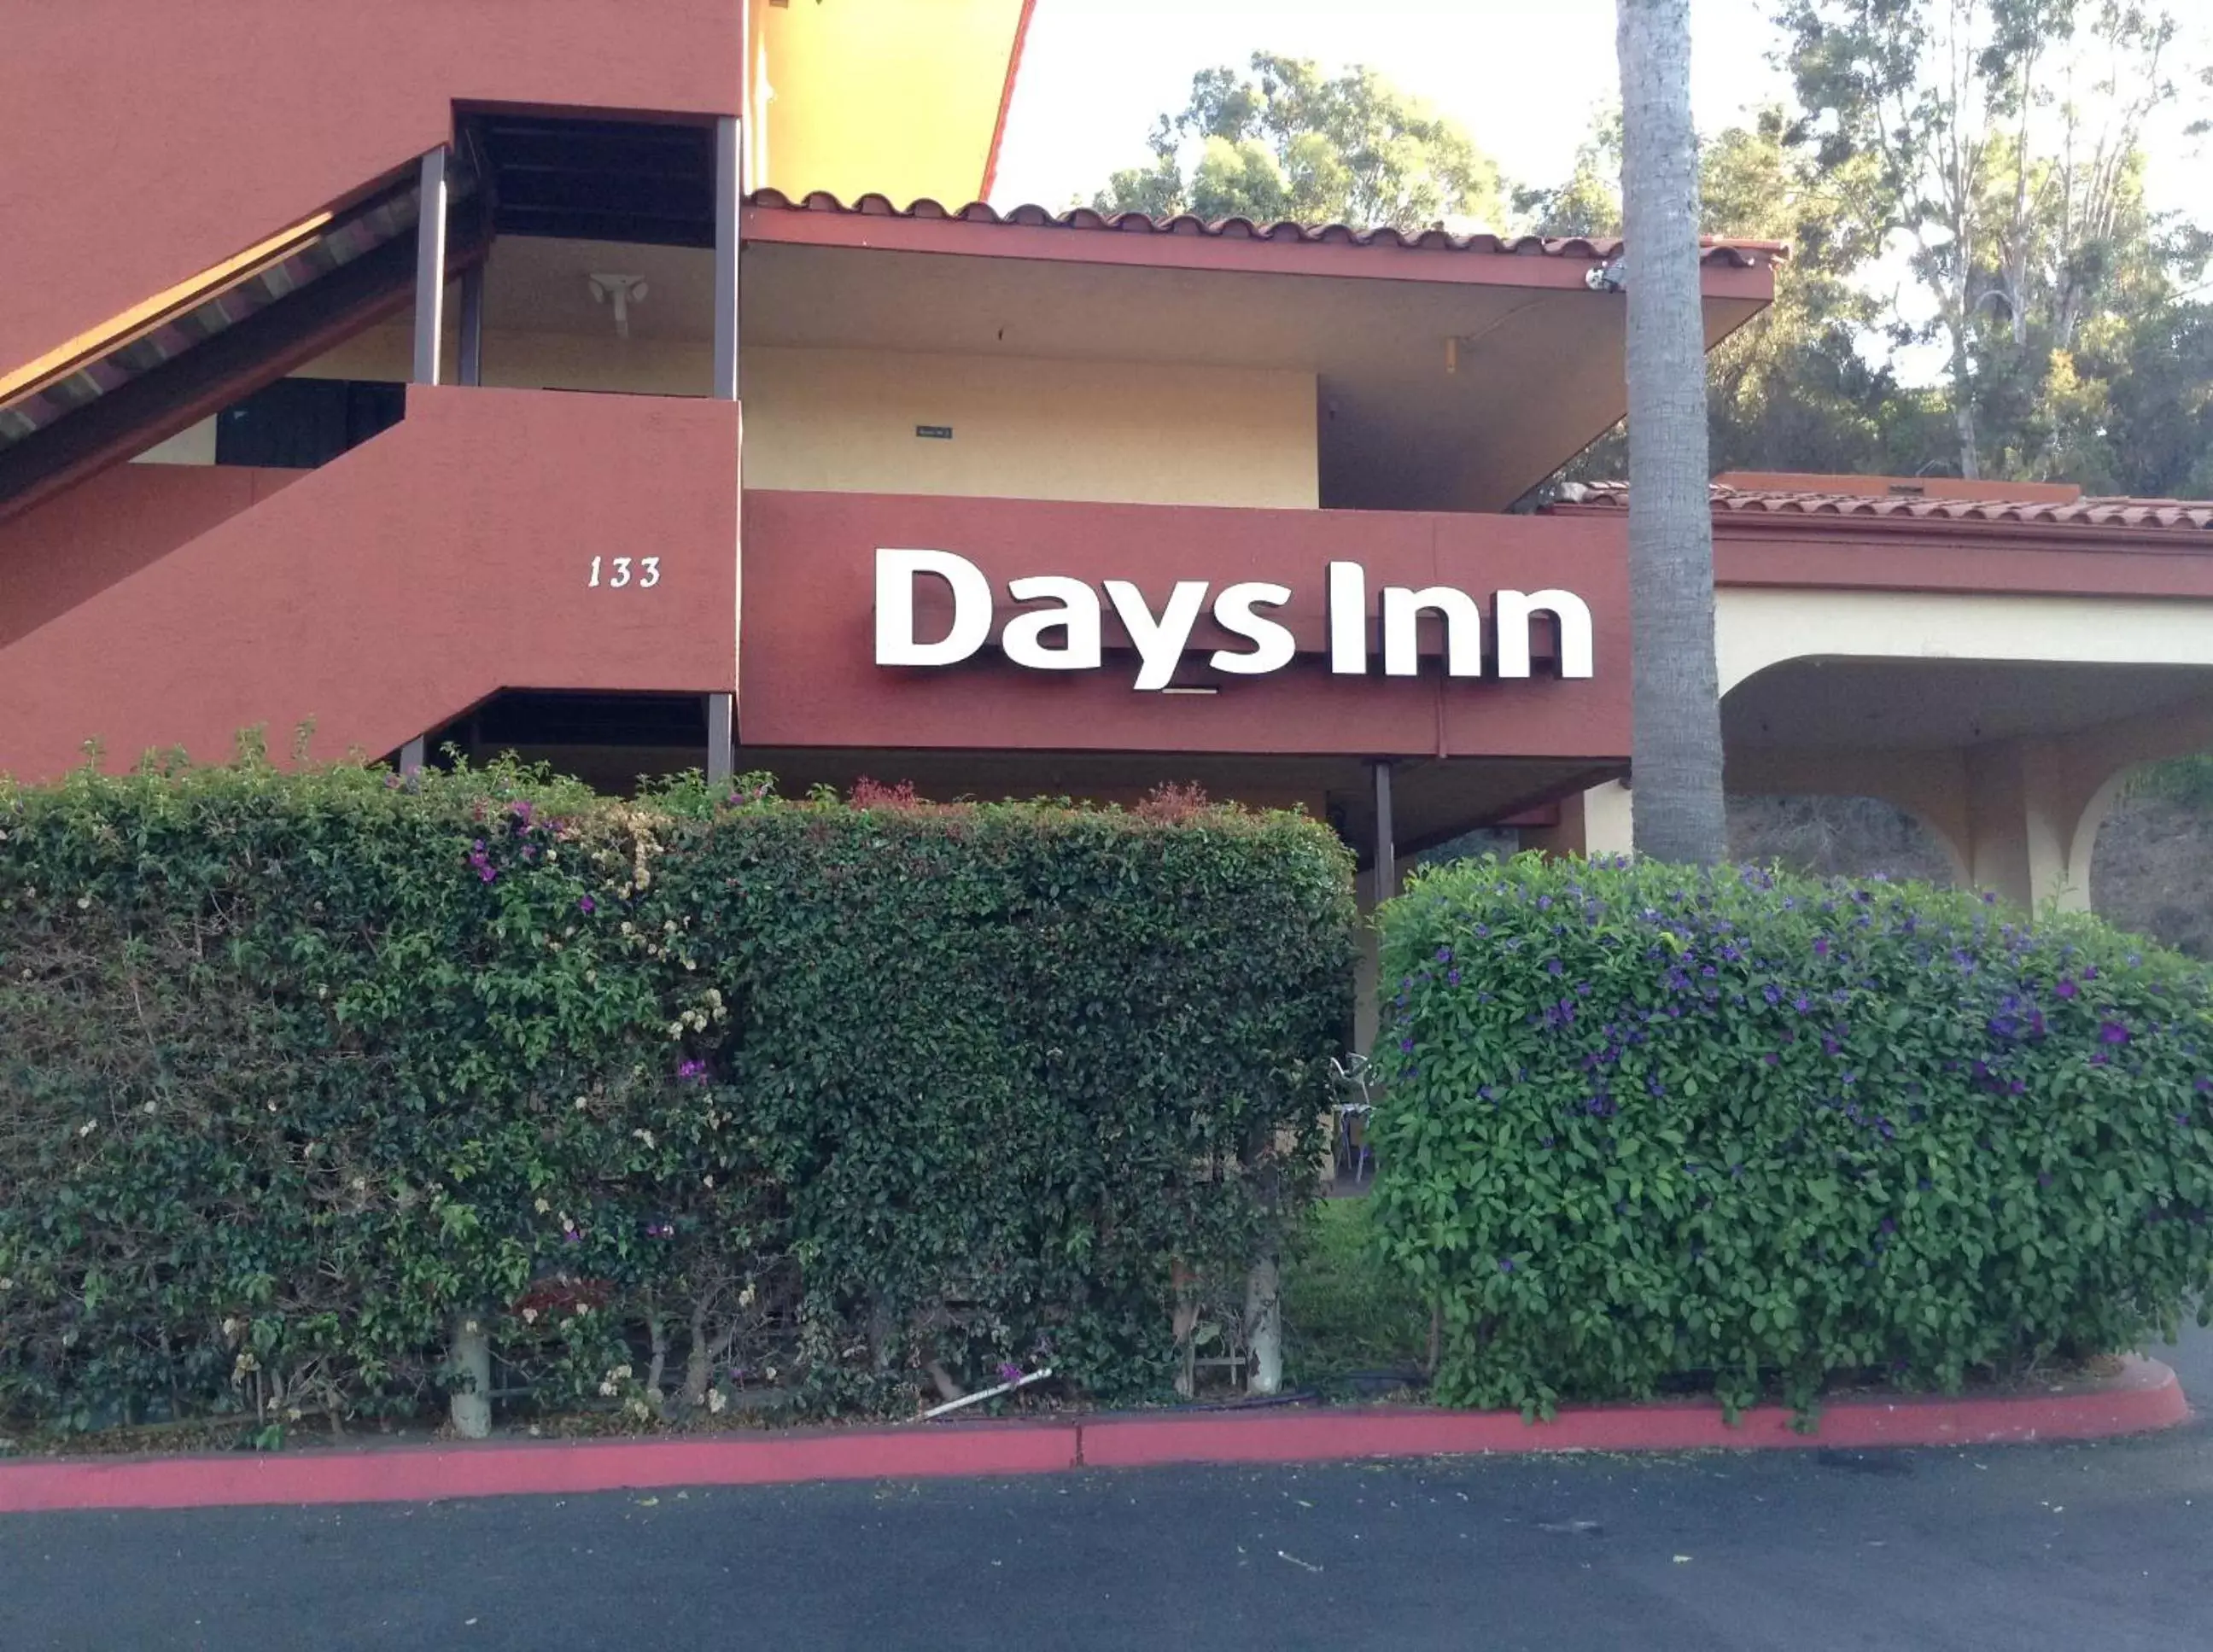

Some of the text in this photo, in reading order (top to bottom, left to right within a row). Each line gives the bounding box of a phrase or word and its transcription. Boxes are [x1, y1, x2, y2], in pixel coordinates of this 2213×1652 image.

[588, 556, 660, 587] 133
[875, 548, 1594, 691] Days Inn
